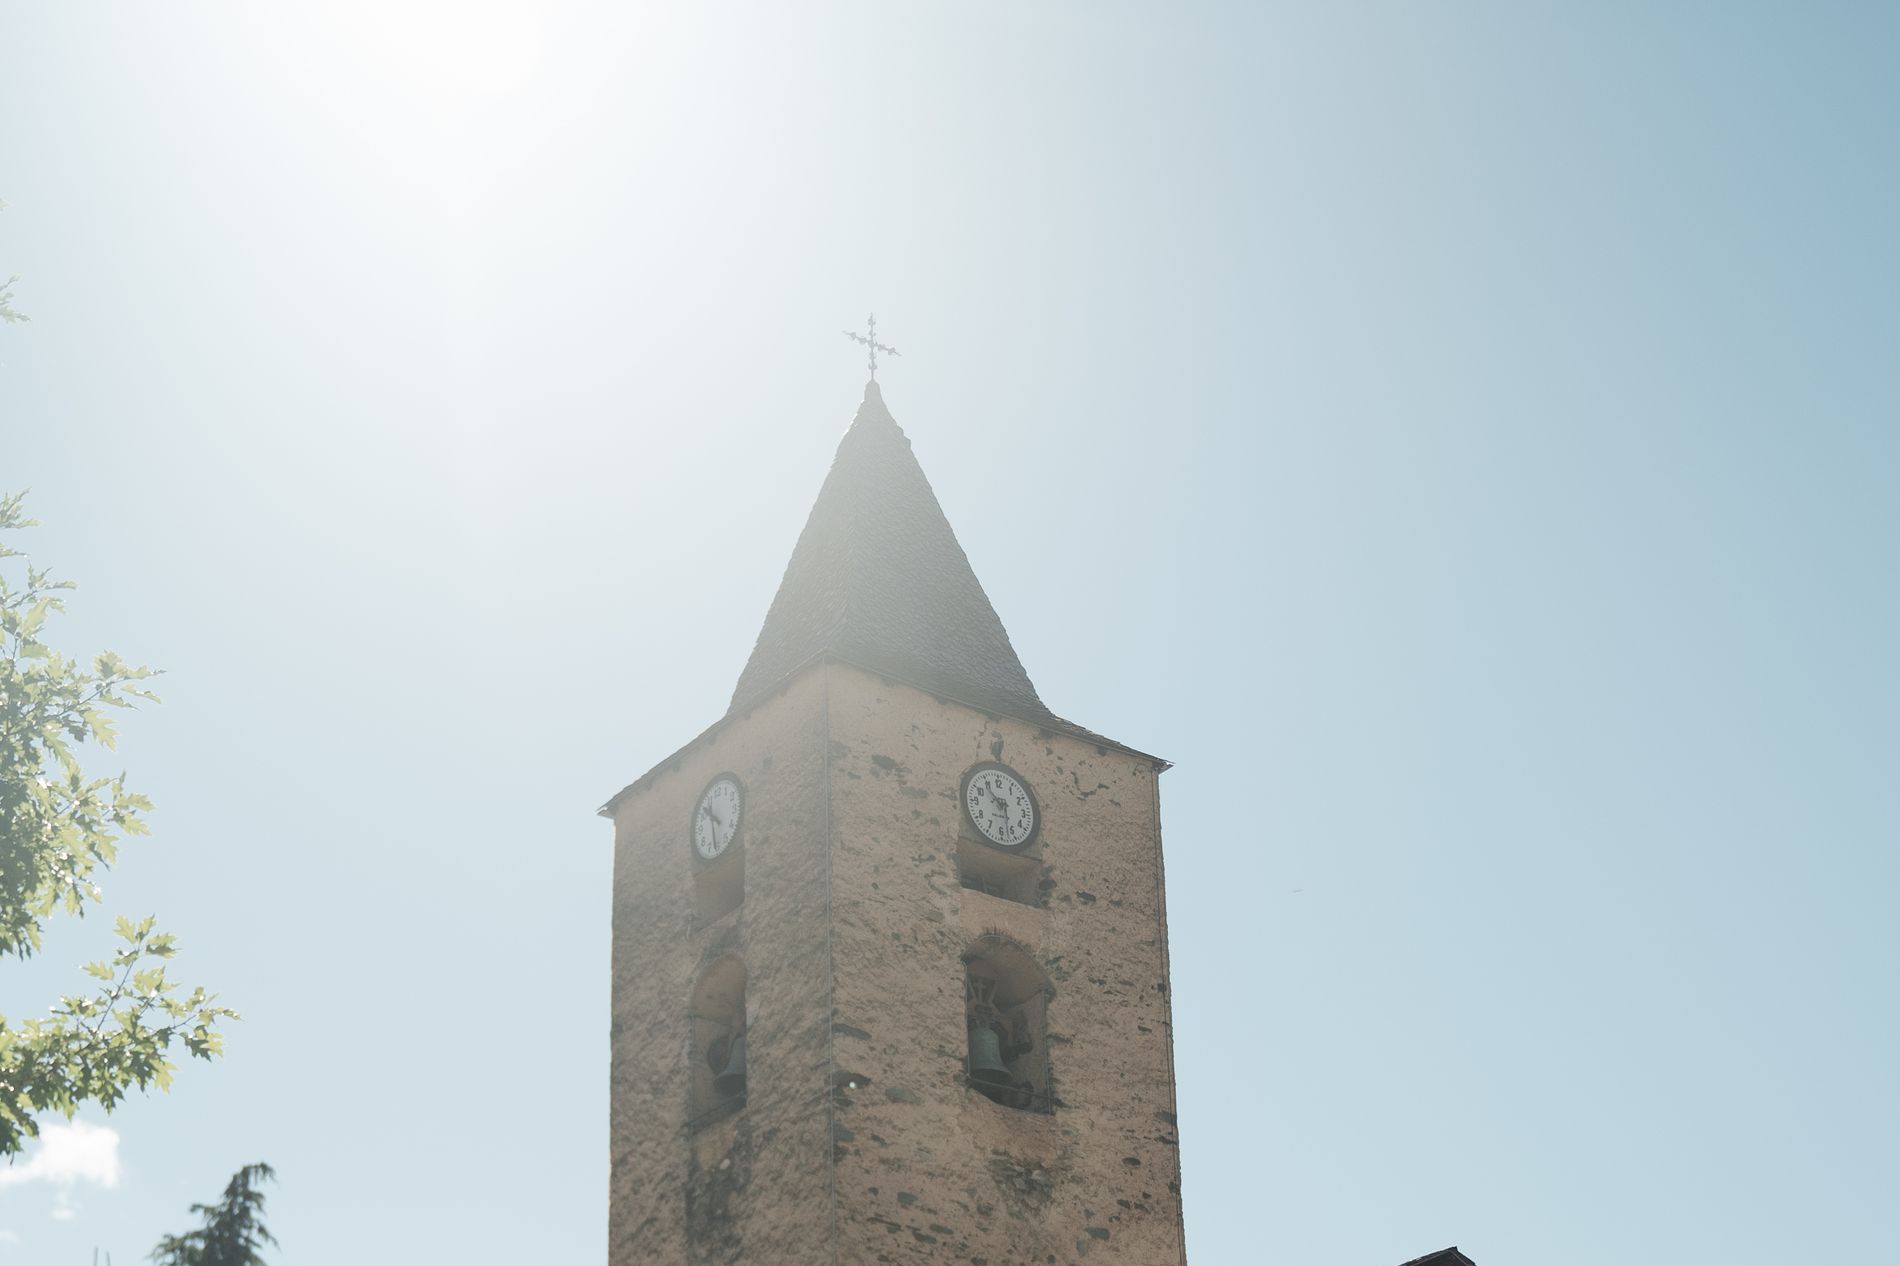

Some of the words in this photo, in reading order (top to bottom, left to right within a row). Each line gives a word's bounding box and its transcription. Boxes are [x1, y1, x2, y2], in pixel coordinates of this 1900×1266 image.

[995, 779, 1003, 789] 12
[977, 787, 984, 796] 10
[974, 796, 978, 806] 9
[1016, 796, 1022, 806] 2
[978, 810, 984, 818] 8
[1021, 809, 1026, 818] 3
[988, 820, 992, 828] 7
[1017, 819, 1022, 828] 4
[999, 826, 1004, 836] 6
[1010, 826, 1015, 835] 5
